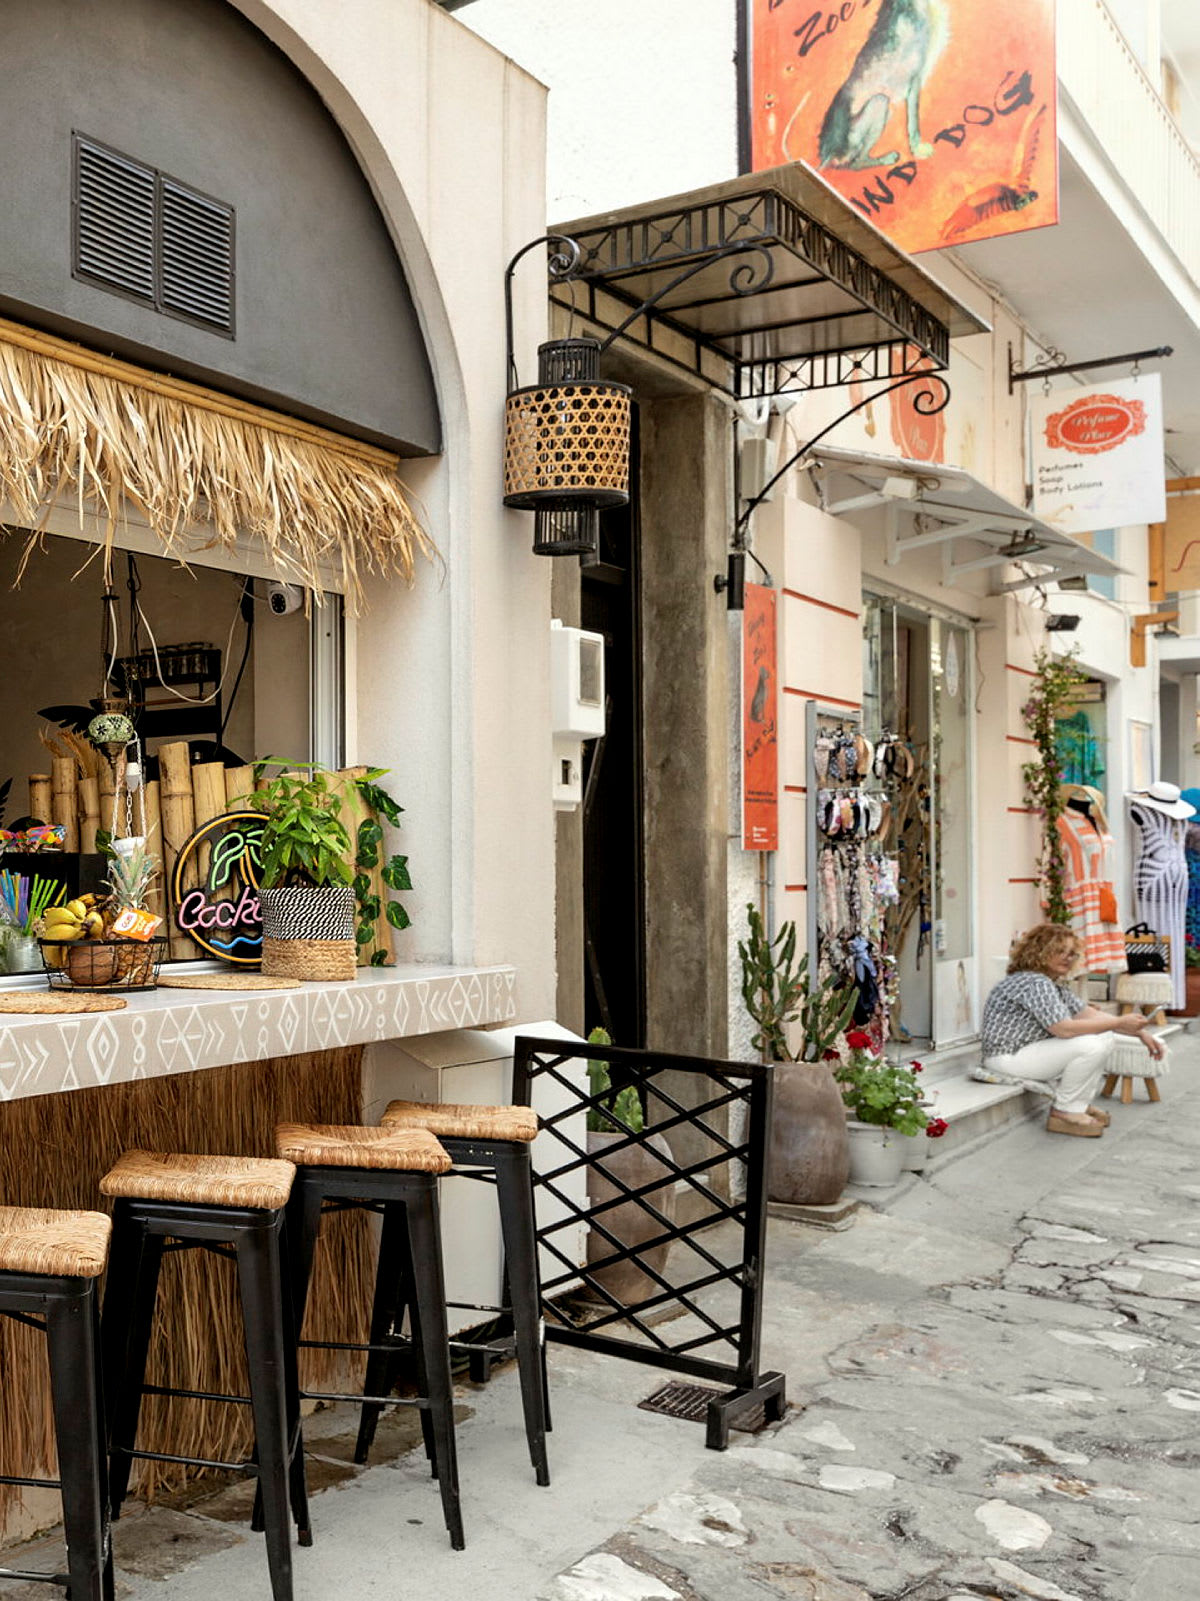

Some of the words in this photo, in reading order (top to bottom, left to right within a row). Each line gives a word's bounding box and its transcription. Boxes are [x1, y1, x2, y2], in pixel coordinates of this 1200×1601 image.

[934, 70, 1035, 148] DOG
[1039, 463, 1083, 473] Perfumes
[1039, 476, 1063, 484] Soap
[1039, 487, 1063, 495] Body
[1067, 481, 1103, 491] Lotions
